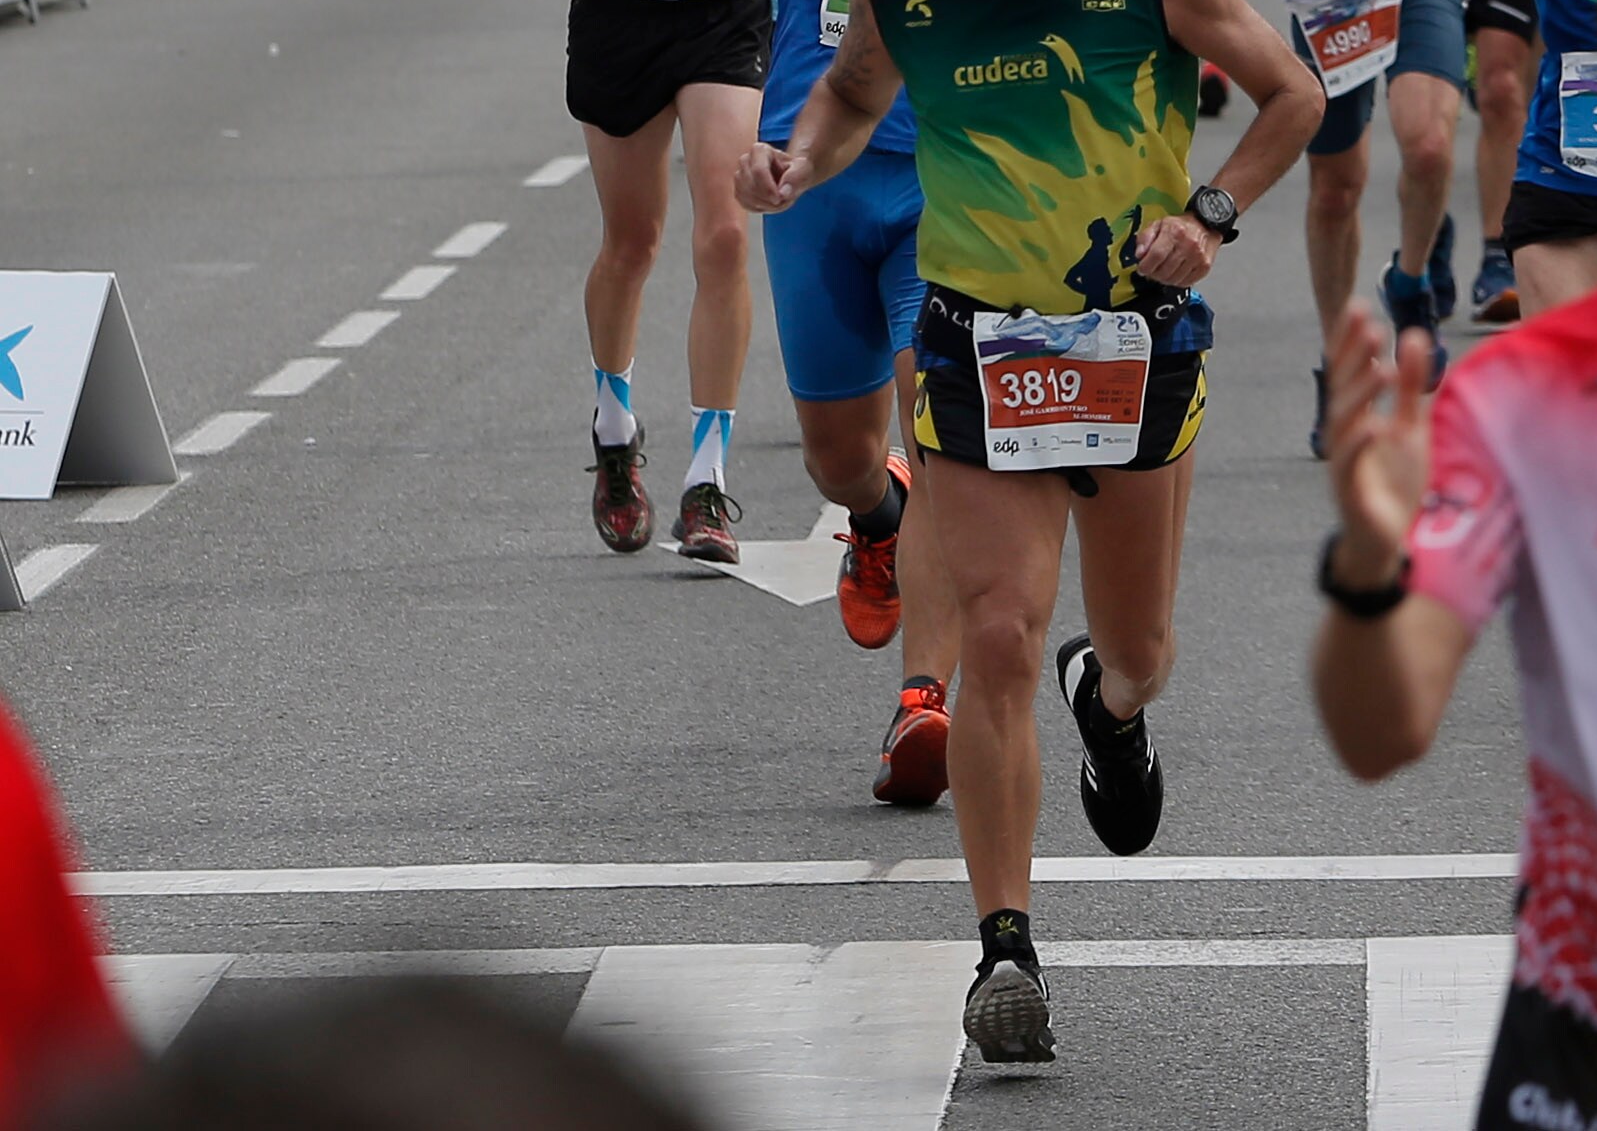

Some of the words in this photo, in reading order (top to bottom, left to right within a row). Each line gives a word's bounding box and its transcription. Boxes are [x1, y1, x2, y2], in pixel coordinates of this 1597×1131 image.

[1322, 20, 1372, 56] 4990
[953, 55, 1049, 87] cudeca
[1000, 368, 1082, 408] 3819
[993, 436, 1020, 457] edp
